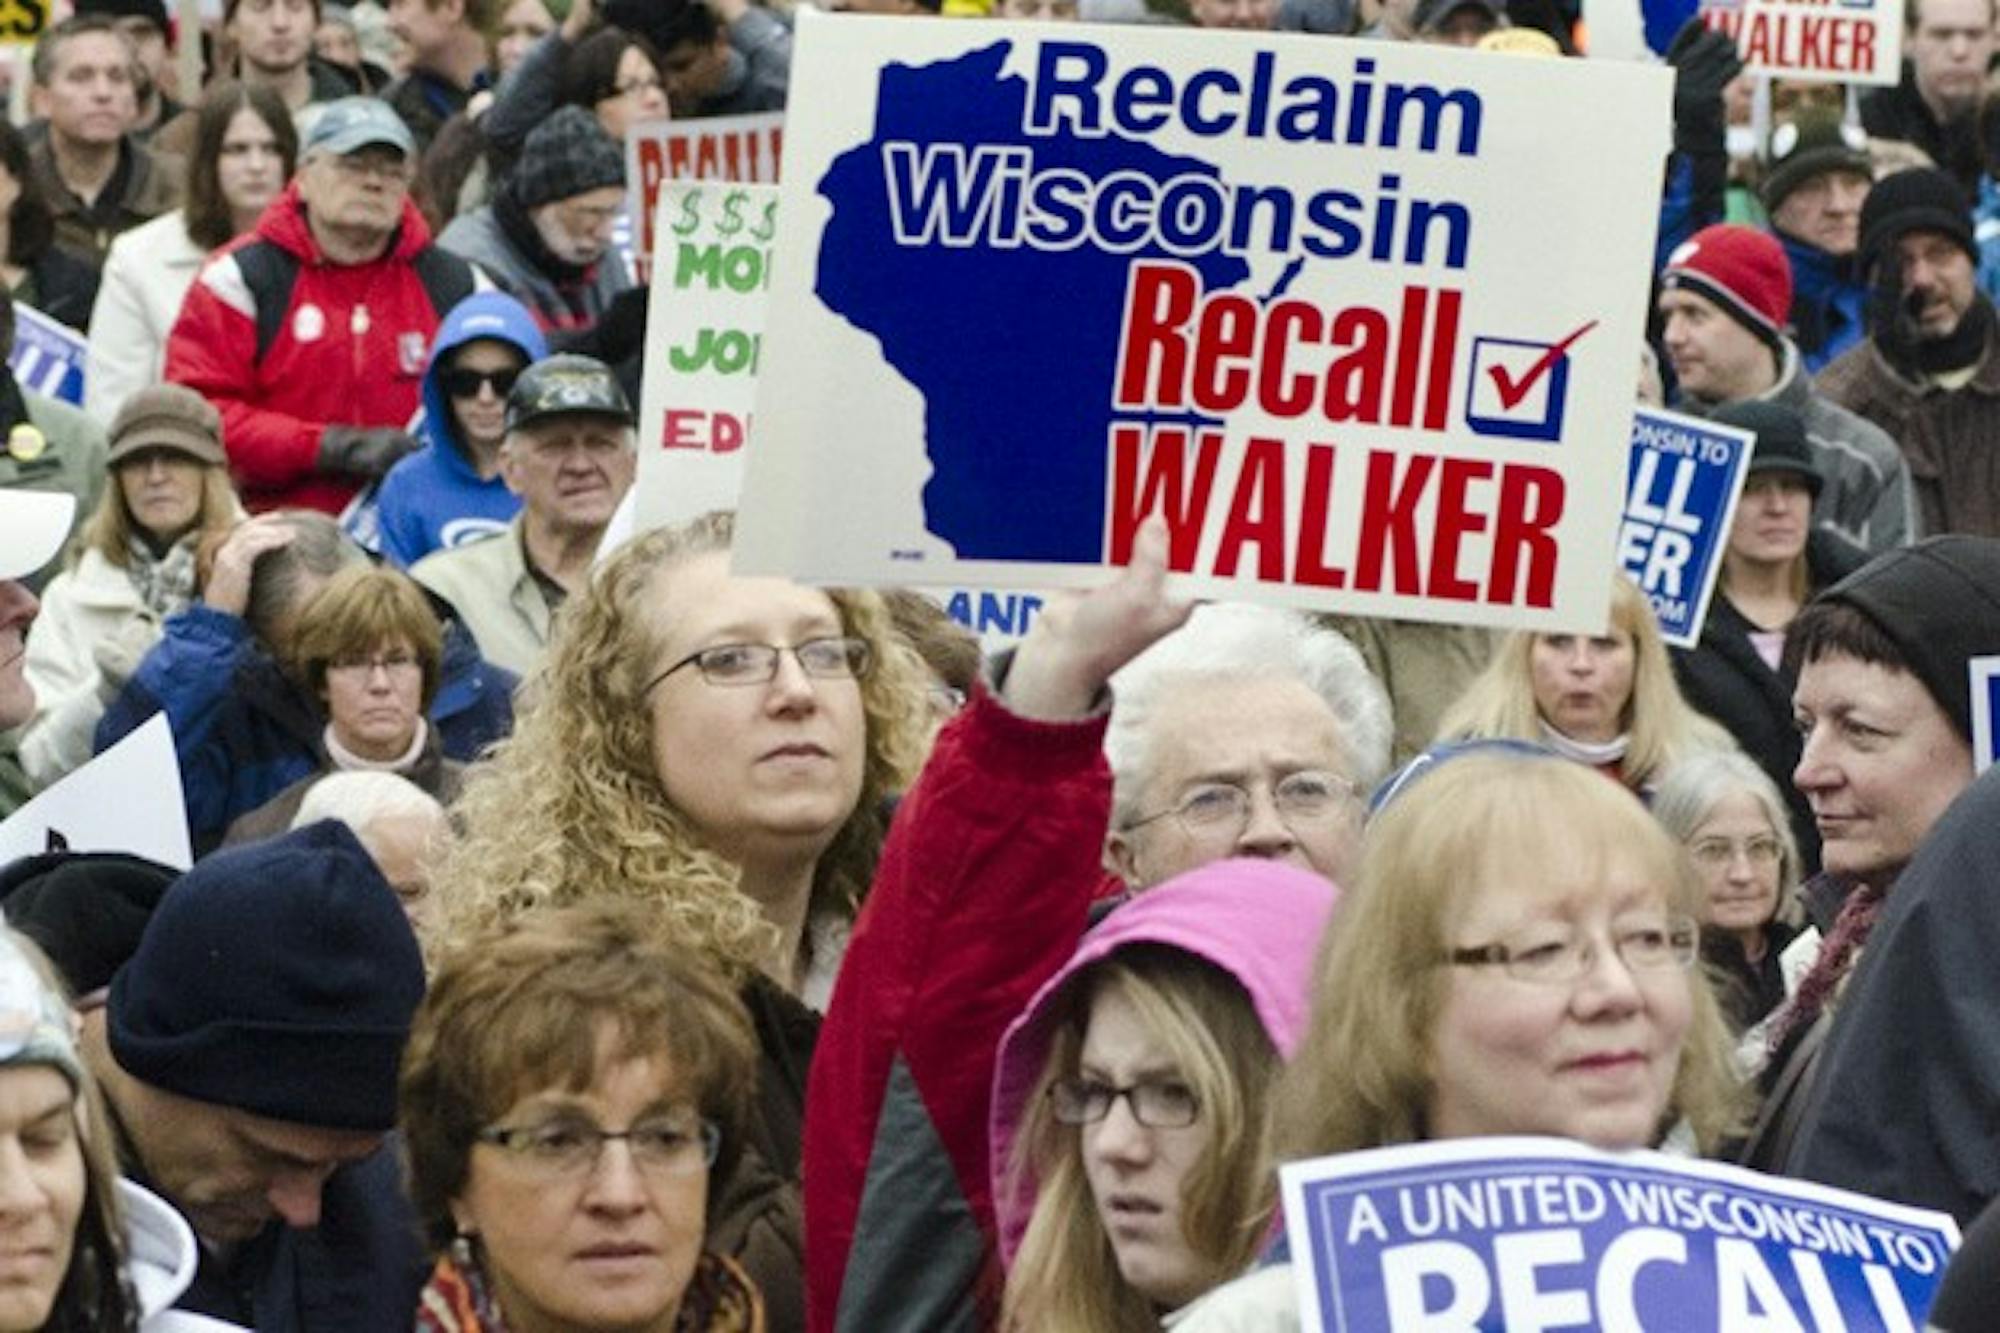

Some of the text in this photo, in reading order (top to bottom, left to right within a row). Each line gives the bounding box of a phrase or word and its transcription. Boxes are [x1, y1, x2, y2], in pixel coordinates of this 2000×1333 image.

[1031, 41, 1482, 156] Reclaim
[885, 143, 1470, 269] Wisconsin
[675, 242, 772, 294] MO
[667, 328, 761, 376] JO
[1119, 267, 1461, 431] Recall
[662, 409, 754, 453] ED
[1697, 438, 1730, 467] TO
[1110, 428, 1566, 609] WALKER
[1347, 1174, 1937, 1275] A UNITED WISCONSIN TO
